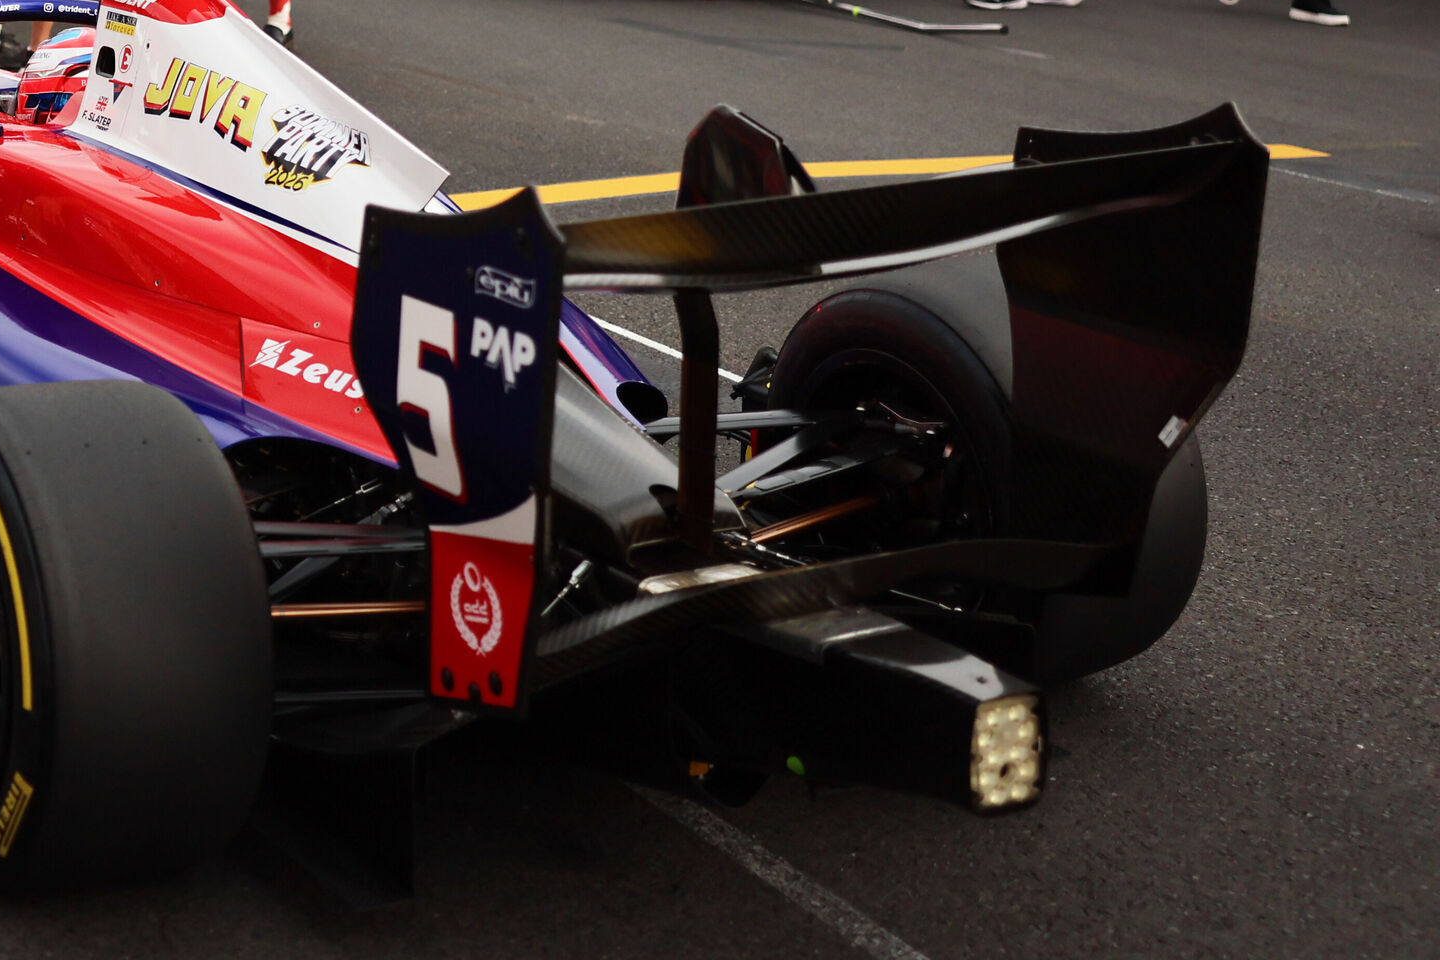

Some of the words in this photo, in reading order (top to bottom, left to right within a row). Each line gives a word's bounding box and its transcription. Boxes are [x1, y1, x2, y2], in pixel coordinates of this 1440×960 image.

[120, 46, 132, 70] E
[88, 112, 112, 127] SLATER
[144, 57, 268, 152] JOVA
[262, 123, 358, 178] PARTY
[273, 103, 372, 167] SUMMER
[264, 167, 310, 192] 2026
[276, 348, 364, 399] Zeus
[470, 317, 536, 387] PAP
[396, 293, 466, 504] 5
